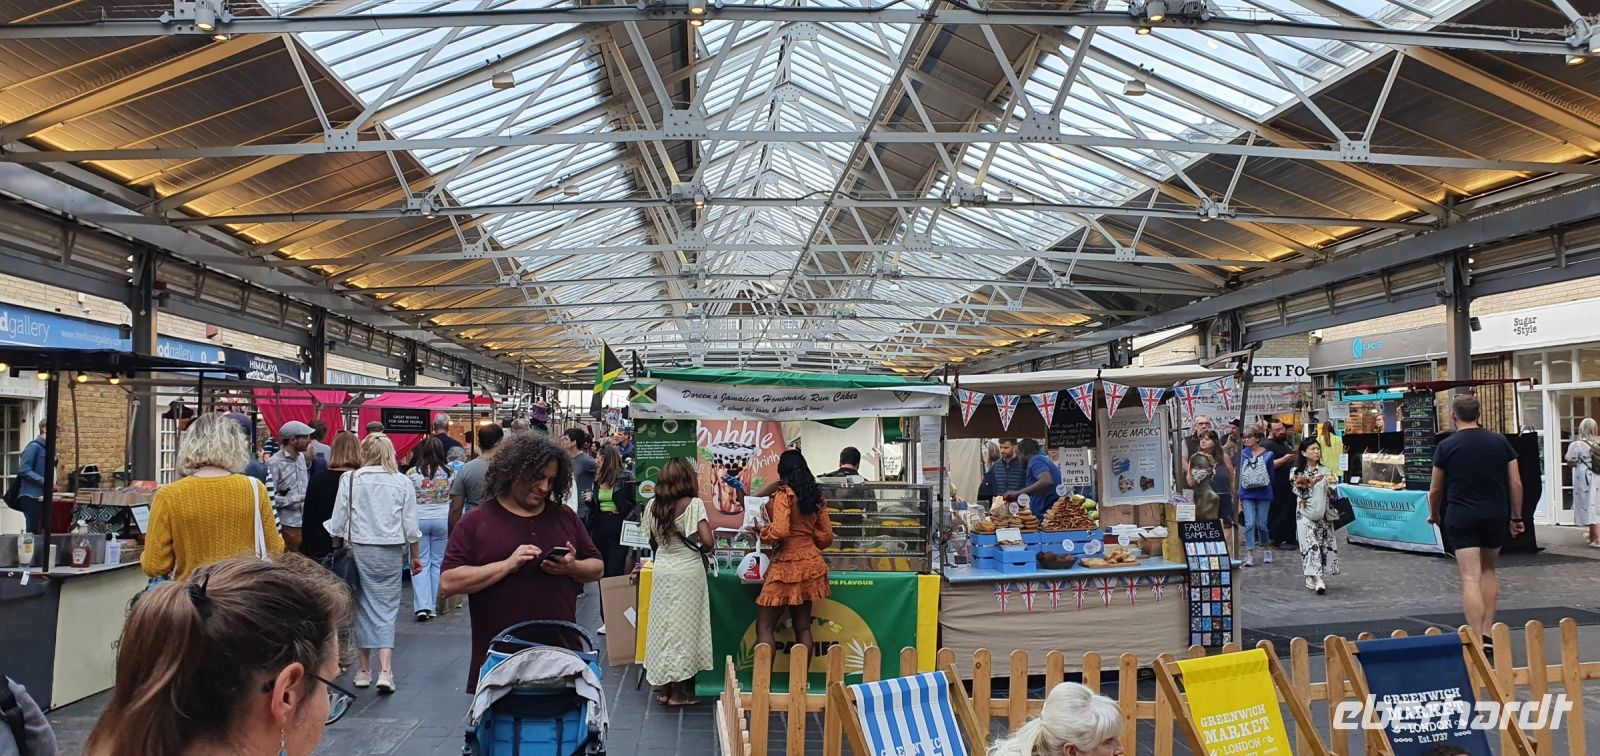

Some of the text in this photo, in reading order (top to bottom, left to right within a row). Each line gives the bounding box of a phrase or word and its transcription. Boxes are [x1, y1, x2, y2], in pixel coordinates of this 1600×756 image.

[1514, 317, 1537, 328] Sugar
[250, 360, 279, 373] HIMALAYA
[681, 389, 858, 403] Doreen's Jamaican Homemade Rum Cakes
[1107, 426, 1161, 439] FACE MASKS
[1391, 501, 1416, 511] ROLLS
[1185, 522, 1215, 532] FABRIC
[1185, 530, 1220, 540] SAMPLES
[1383, 687, 1462, 706] GREENWICH
[1200, 704, 1266, 728] GREENWICH
[1387, 701, 1465, 721] MARKET
[1203, 716, 1270, 745] MARKET
[1408, 719, 1453, 734] LONDON
[1418, 732, 1449, 744] Est. 1737
[1223, 738, 1262, 755] LONDON
